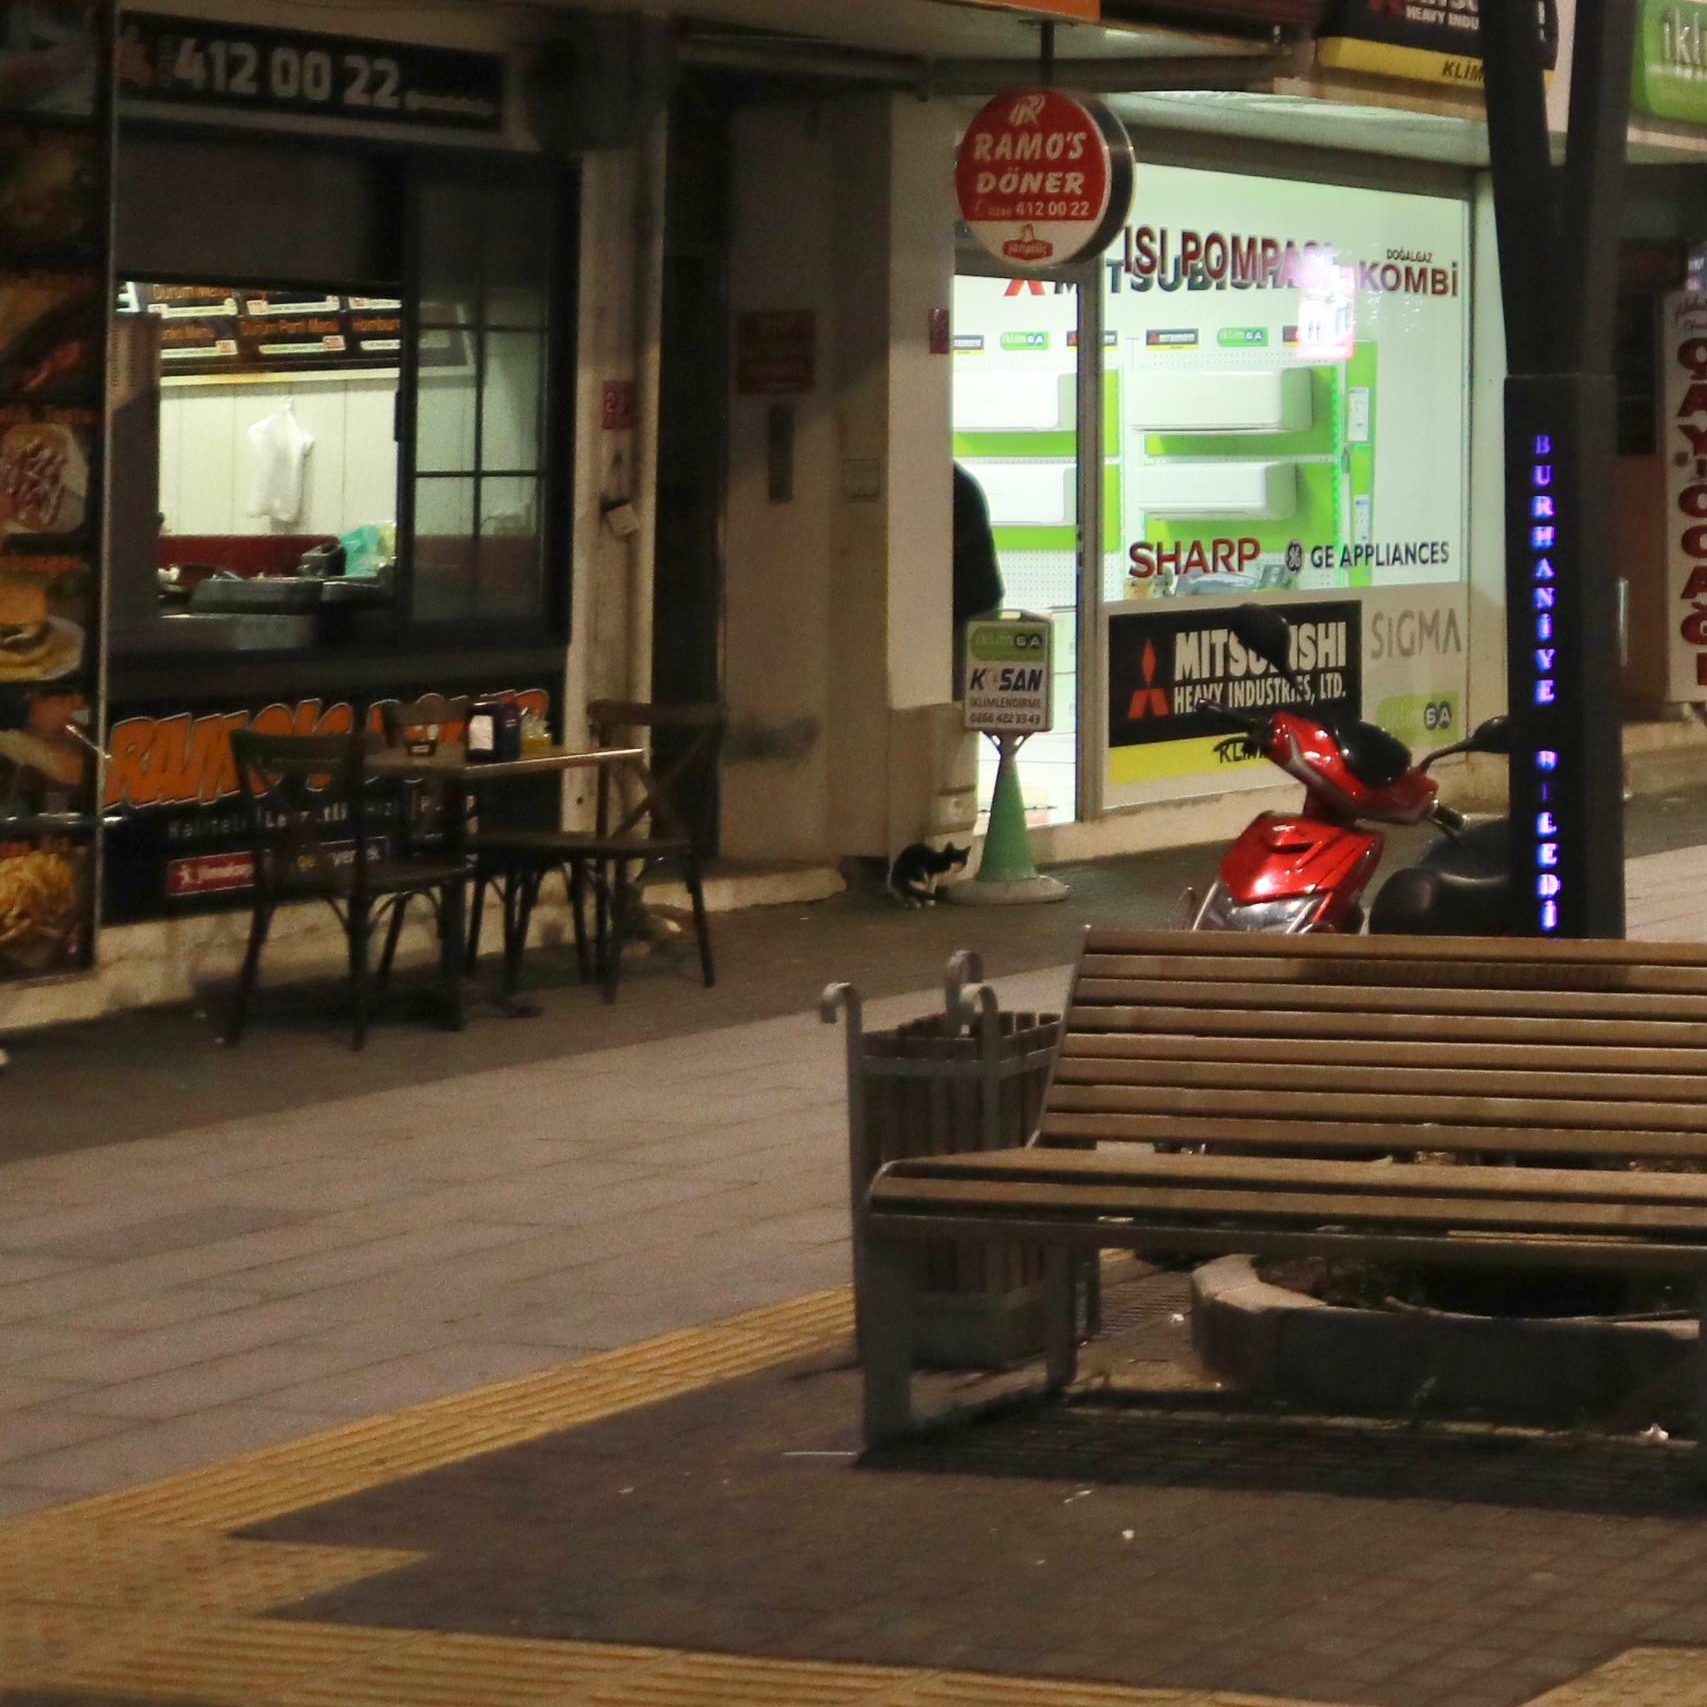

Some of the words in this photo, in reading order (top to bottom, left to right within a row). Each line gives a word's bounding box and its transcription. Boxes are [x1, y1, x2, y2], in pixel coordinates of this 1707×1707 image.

[269, 45, 333, 102] 00
[342, 53, 401, 106] 22
[973, 131, 1087, 162] RAMO'S
[976, 168, 1085, 195] DÖNER
[1016, 200, 1046, 218] 412
[1070, 201, 1091, 218] 22
[1385, 247, 1433, 263] DOĞALGAZ
[1358, 260, 1459, 299] KOMBİ
[1129, 537, 1262, 579] SHARP
[1310, 544, 1336, 570] GE
[1340, 540, 1450, 568] APPLIANCES
[1533, 434, 1555, 706] BURHANİYE
[1318, 673, 1348, 701] LTD.
